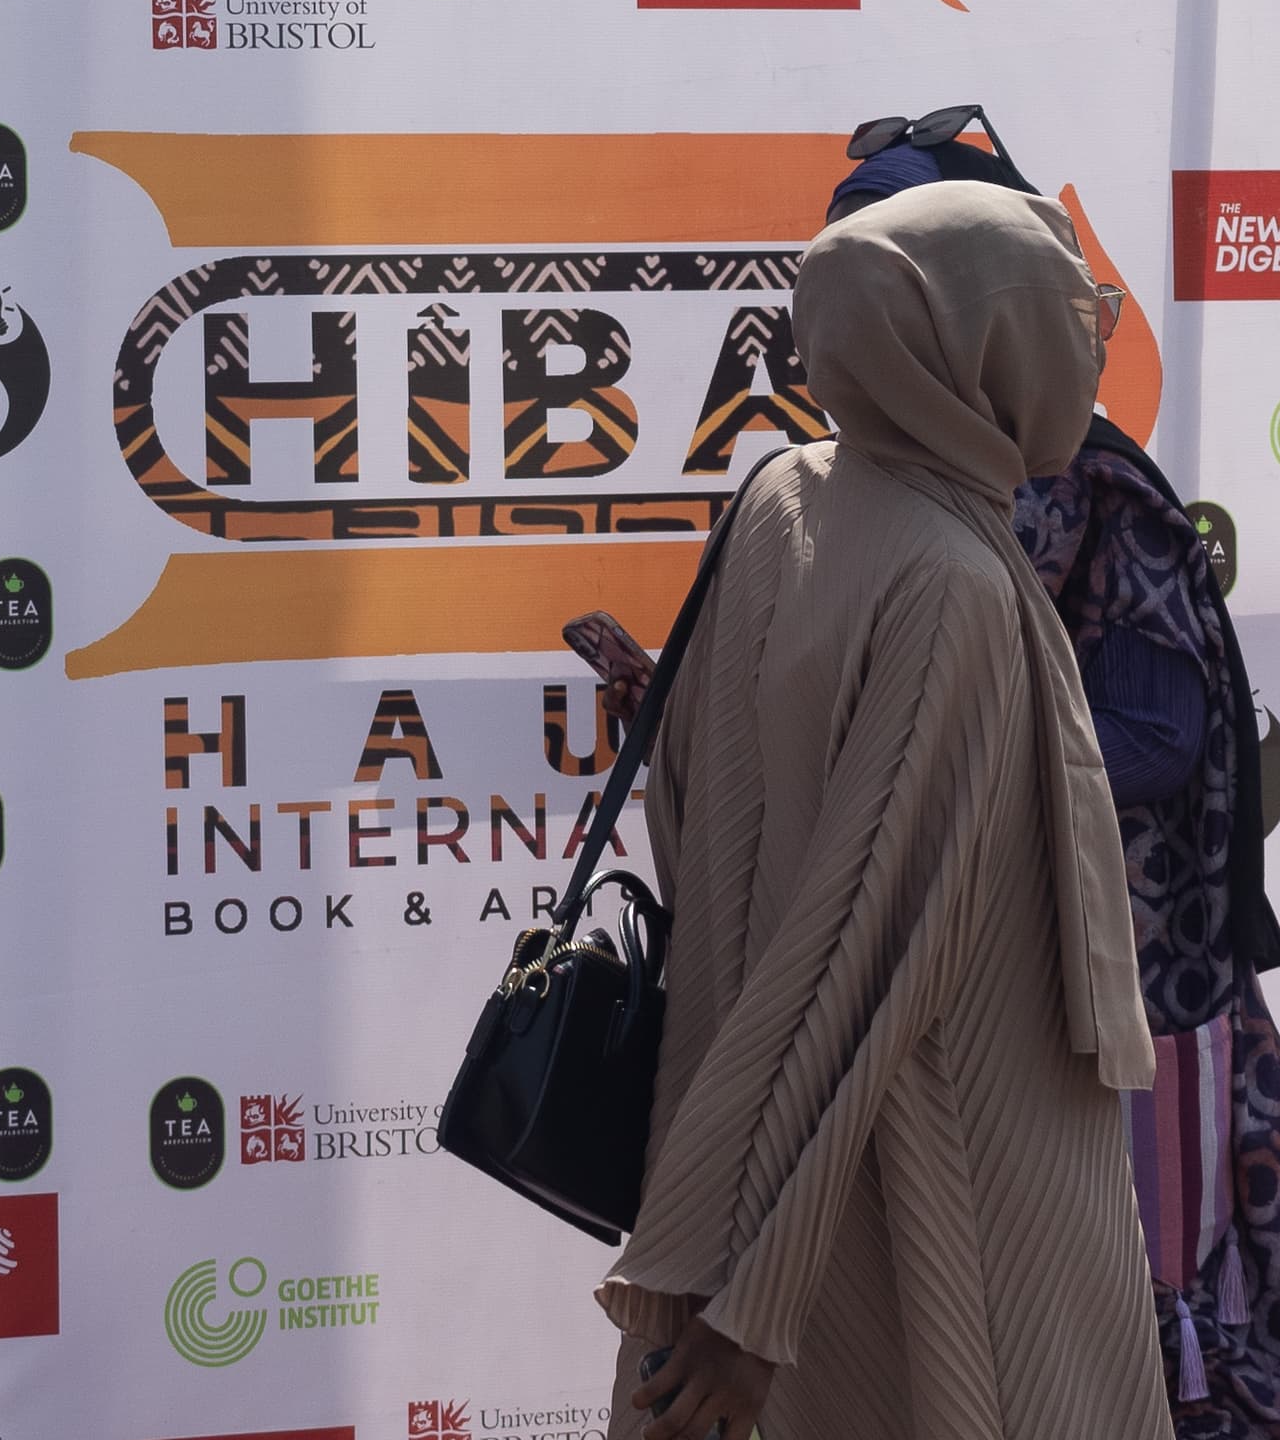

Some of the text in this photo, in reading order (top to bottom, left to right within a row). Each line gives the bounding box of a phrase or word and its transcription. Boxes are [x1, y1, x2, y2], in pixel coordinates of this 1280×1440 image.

[1221, 204, 1240, 213] THE
[164, 684, 621, 788] HAU
[166, 790, 645, 876] INTERNA
[164, 895, 354, 936] BOOK
[404, 891, 432, 926] &
[313, 1100, 427, 1125] University
[165, 1119, 210, 1136] TEA
[313, 1127, 443, 1160] BRISTO
[278, 1274, 379, 1302] GOETHE
[280, 1302, 379, 1329] INSTITUT
[480, 1403, 610, 1429] University o
